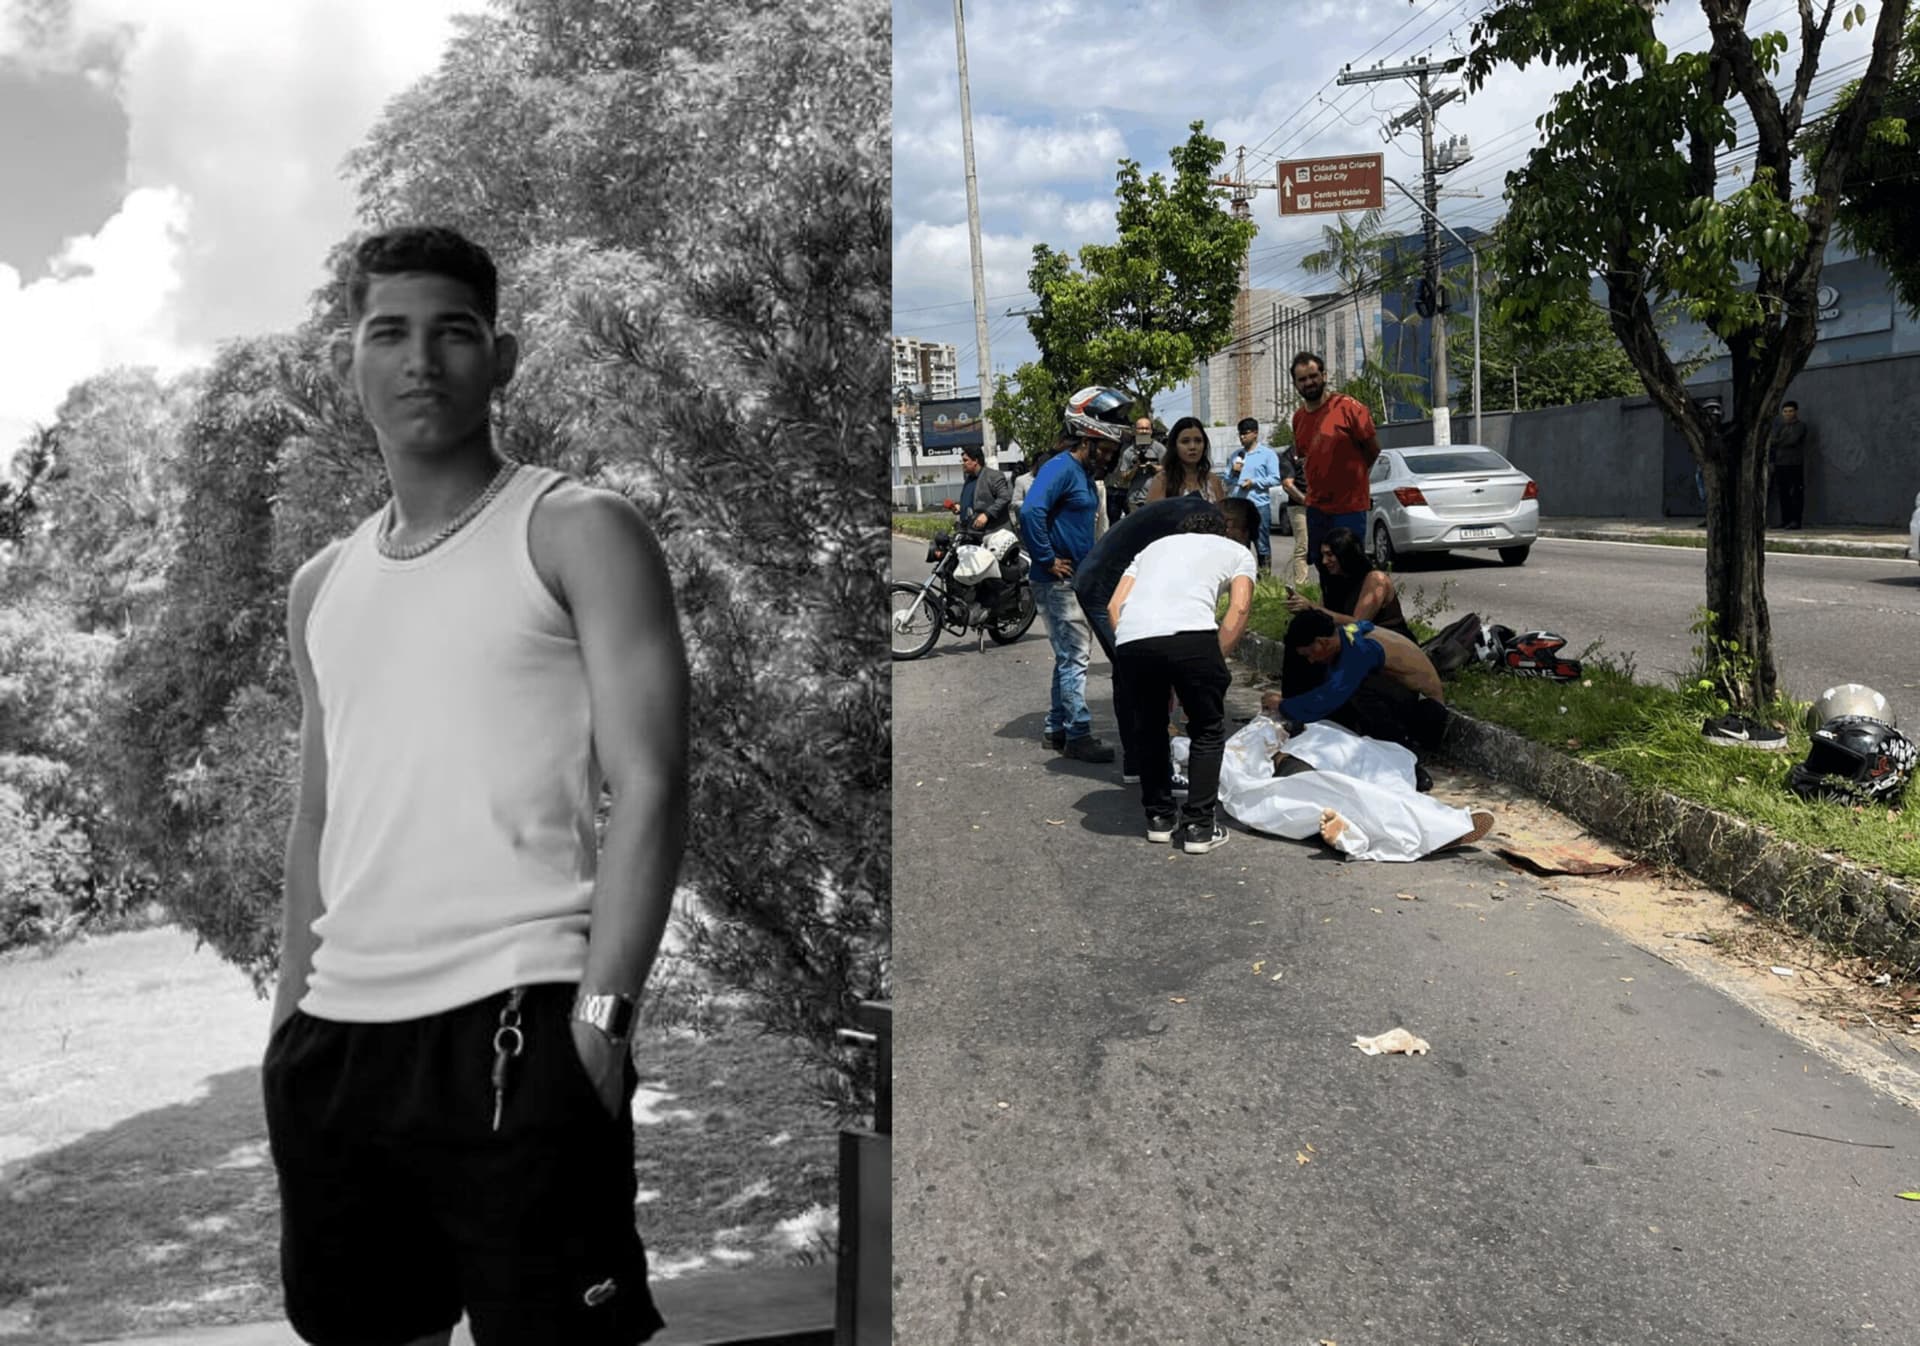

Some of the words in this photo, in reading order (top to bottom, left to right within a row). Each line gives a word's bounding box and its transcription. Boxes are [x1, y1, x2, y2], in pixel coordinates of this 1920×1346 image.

[1349, 161, 1376, 169] Criança
[1314, 174, 1332, 182] Child
[1334, 173, 1348, 181] City
[1339, 188, 1370, 197] Histórico
